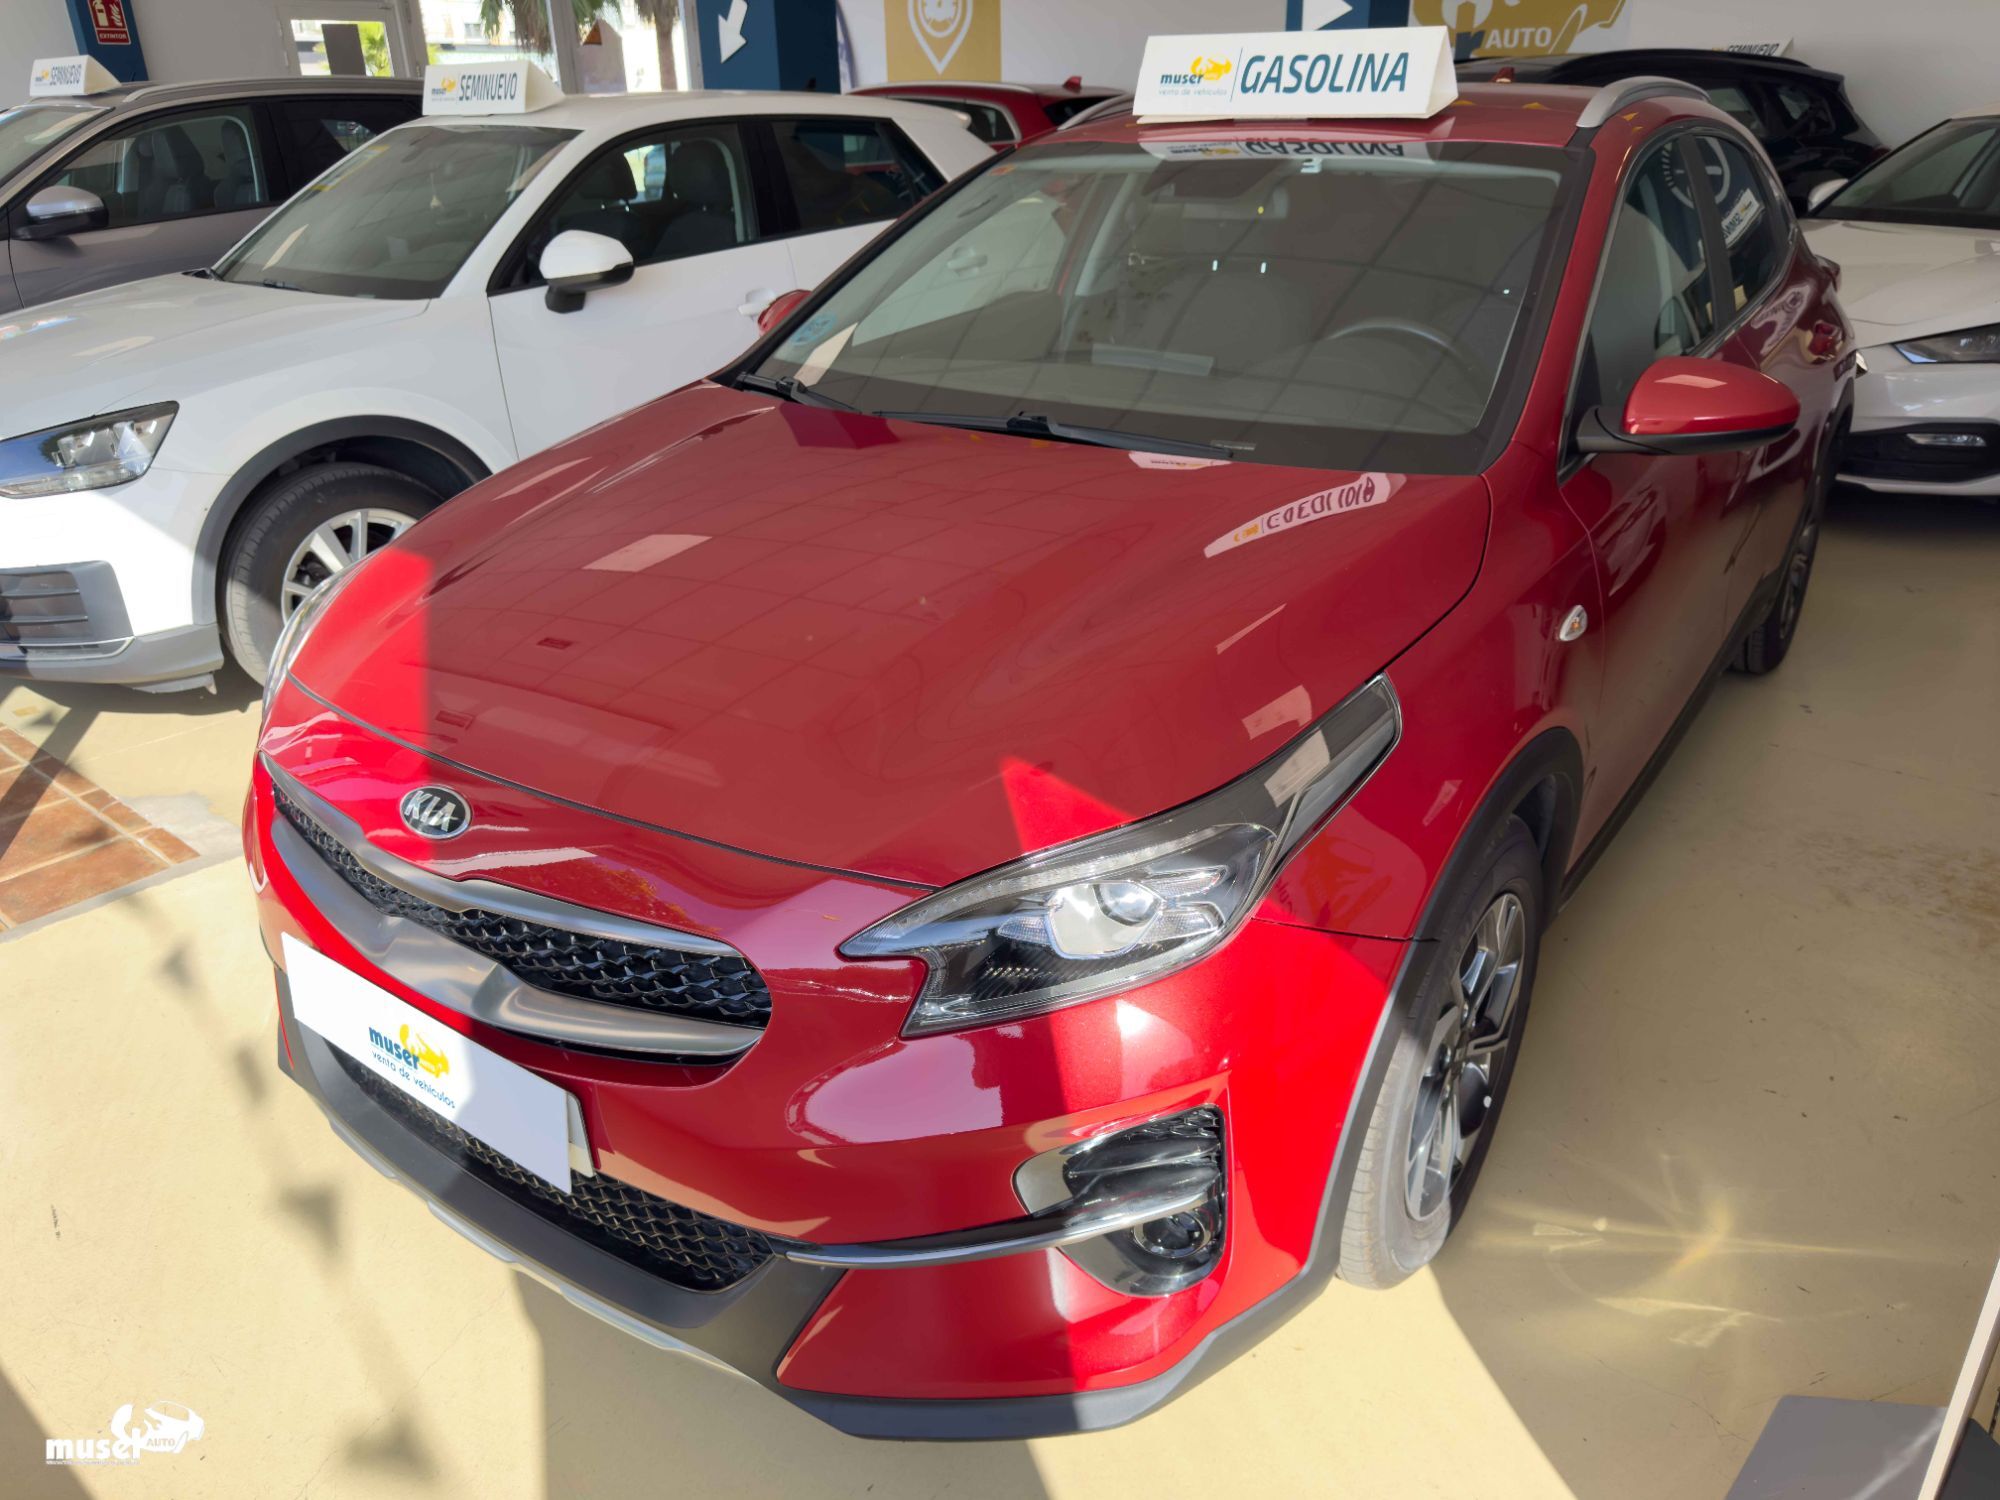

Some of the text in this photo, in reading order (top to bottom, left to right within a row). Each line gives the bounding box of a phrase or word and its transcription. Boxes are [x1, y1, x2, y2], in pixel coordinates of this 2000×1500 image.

[1486, 27, 1551, 48] AUTO
[459, 72, 518, 101] SEMINUEVO
[1160, 73, 1204, 84] muser
[1240, 52, 1409, 93] GASOLINA
[404, 790, 456, 832] KIA
[369, 1026, 420, 1069] muser
[371, 1051, 396, 1072] venta
[399, 1066, 410, 1081] de
